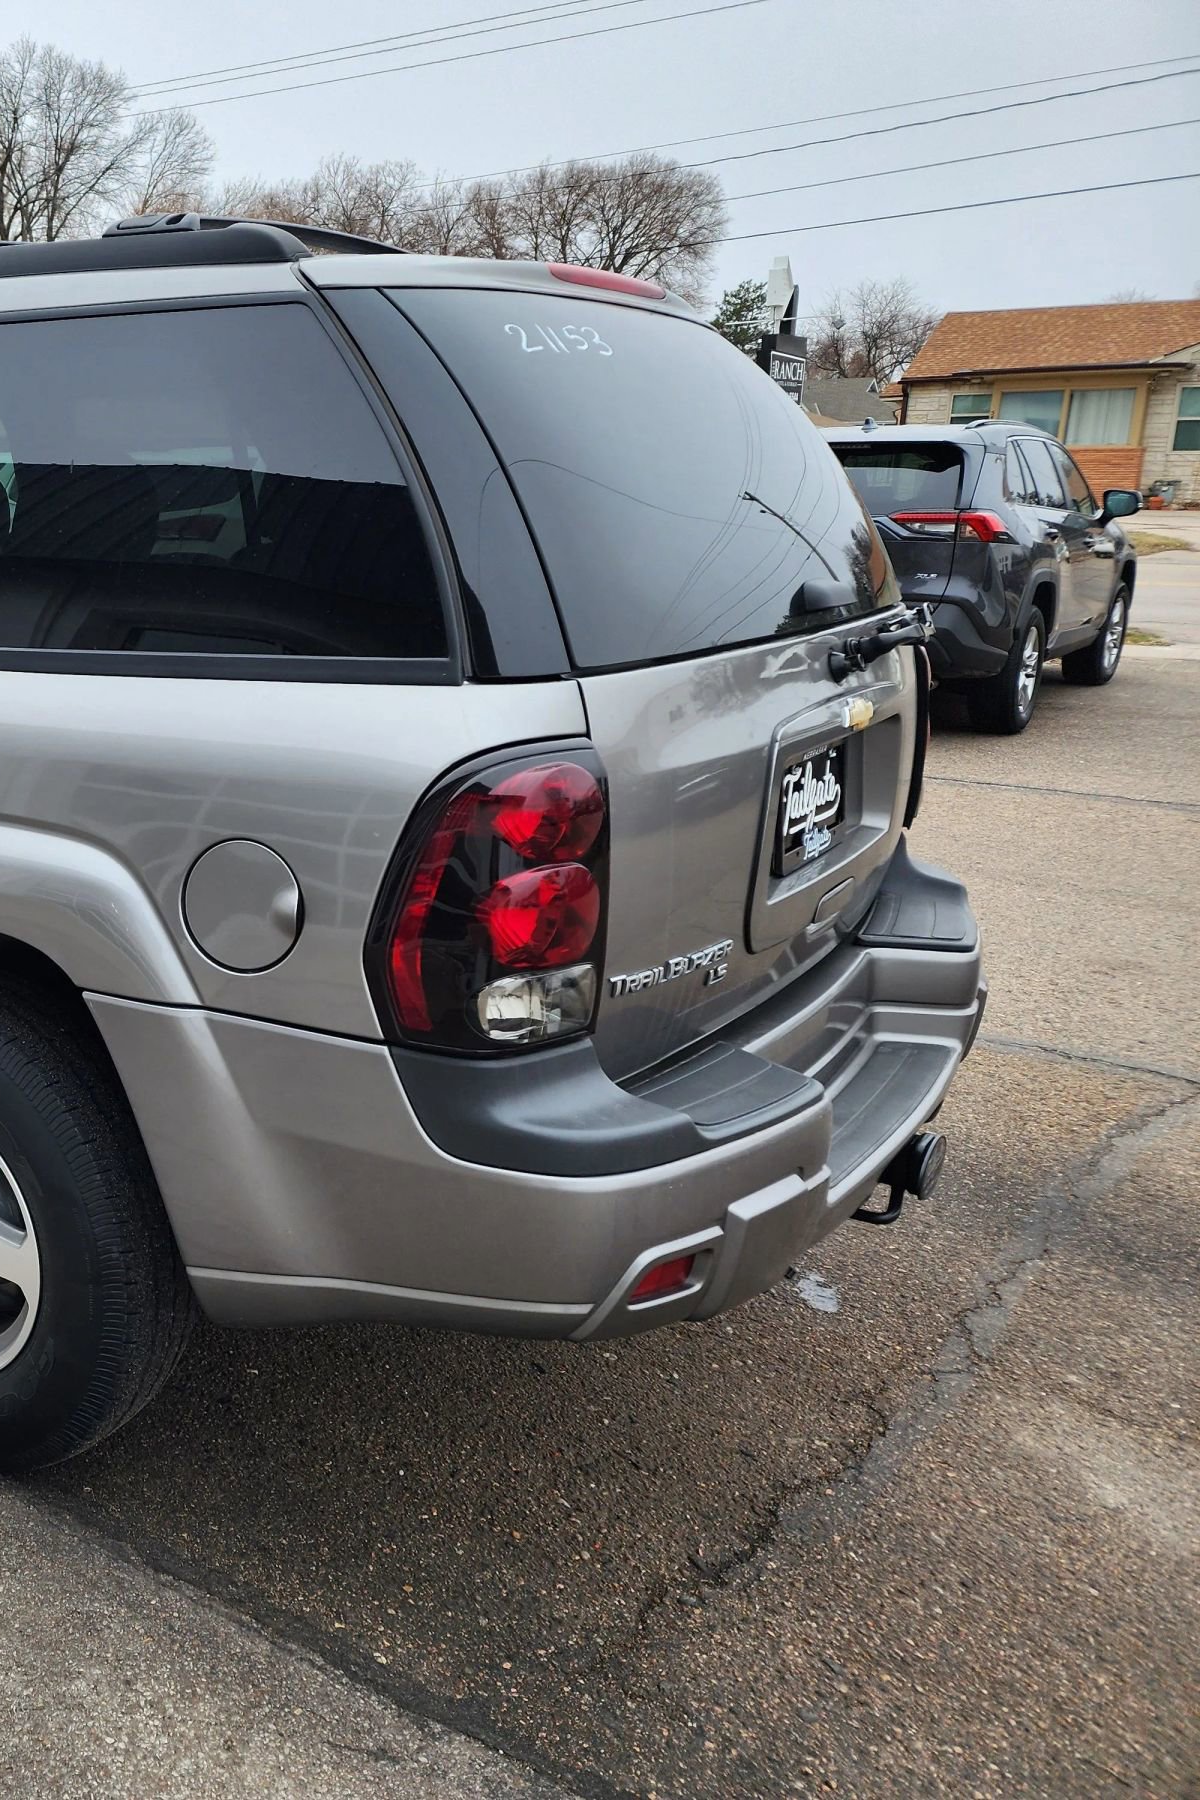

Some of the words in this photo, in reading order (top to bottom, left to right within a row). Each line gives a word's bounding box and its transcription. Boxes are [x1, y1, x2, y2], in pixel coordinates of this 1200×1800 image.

[504, 323, 613, 356] 21153
[774, 360, 804, 381] RANCH
[783, 760, 841, 836] Tailgate
[707, 963, 728, 986] LS
